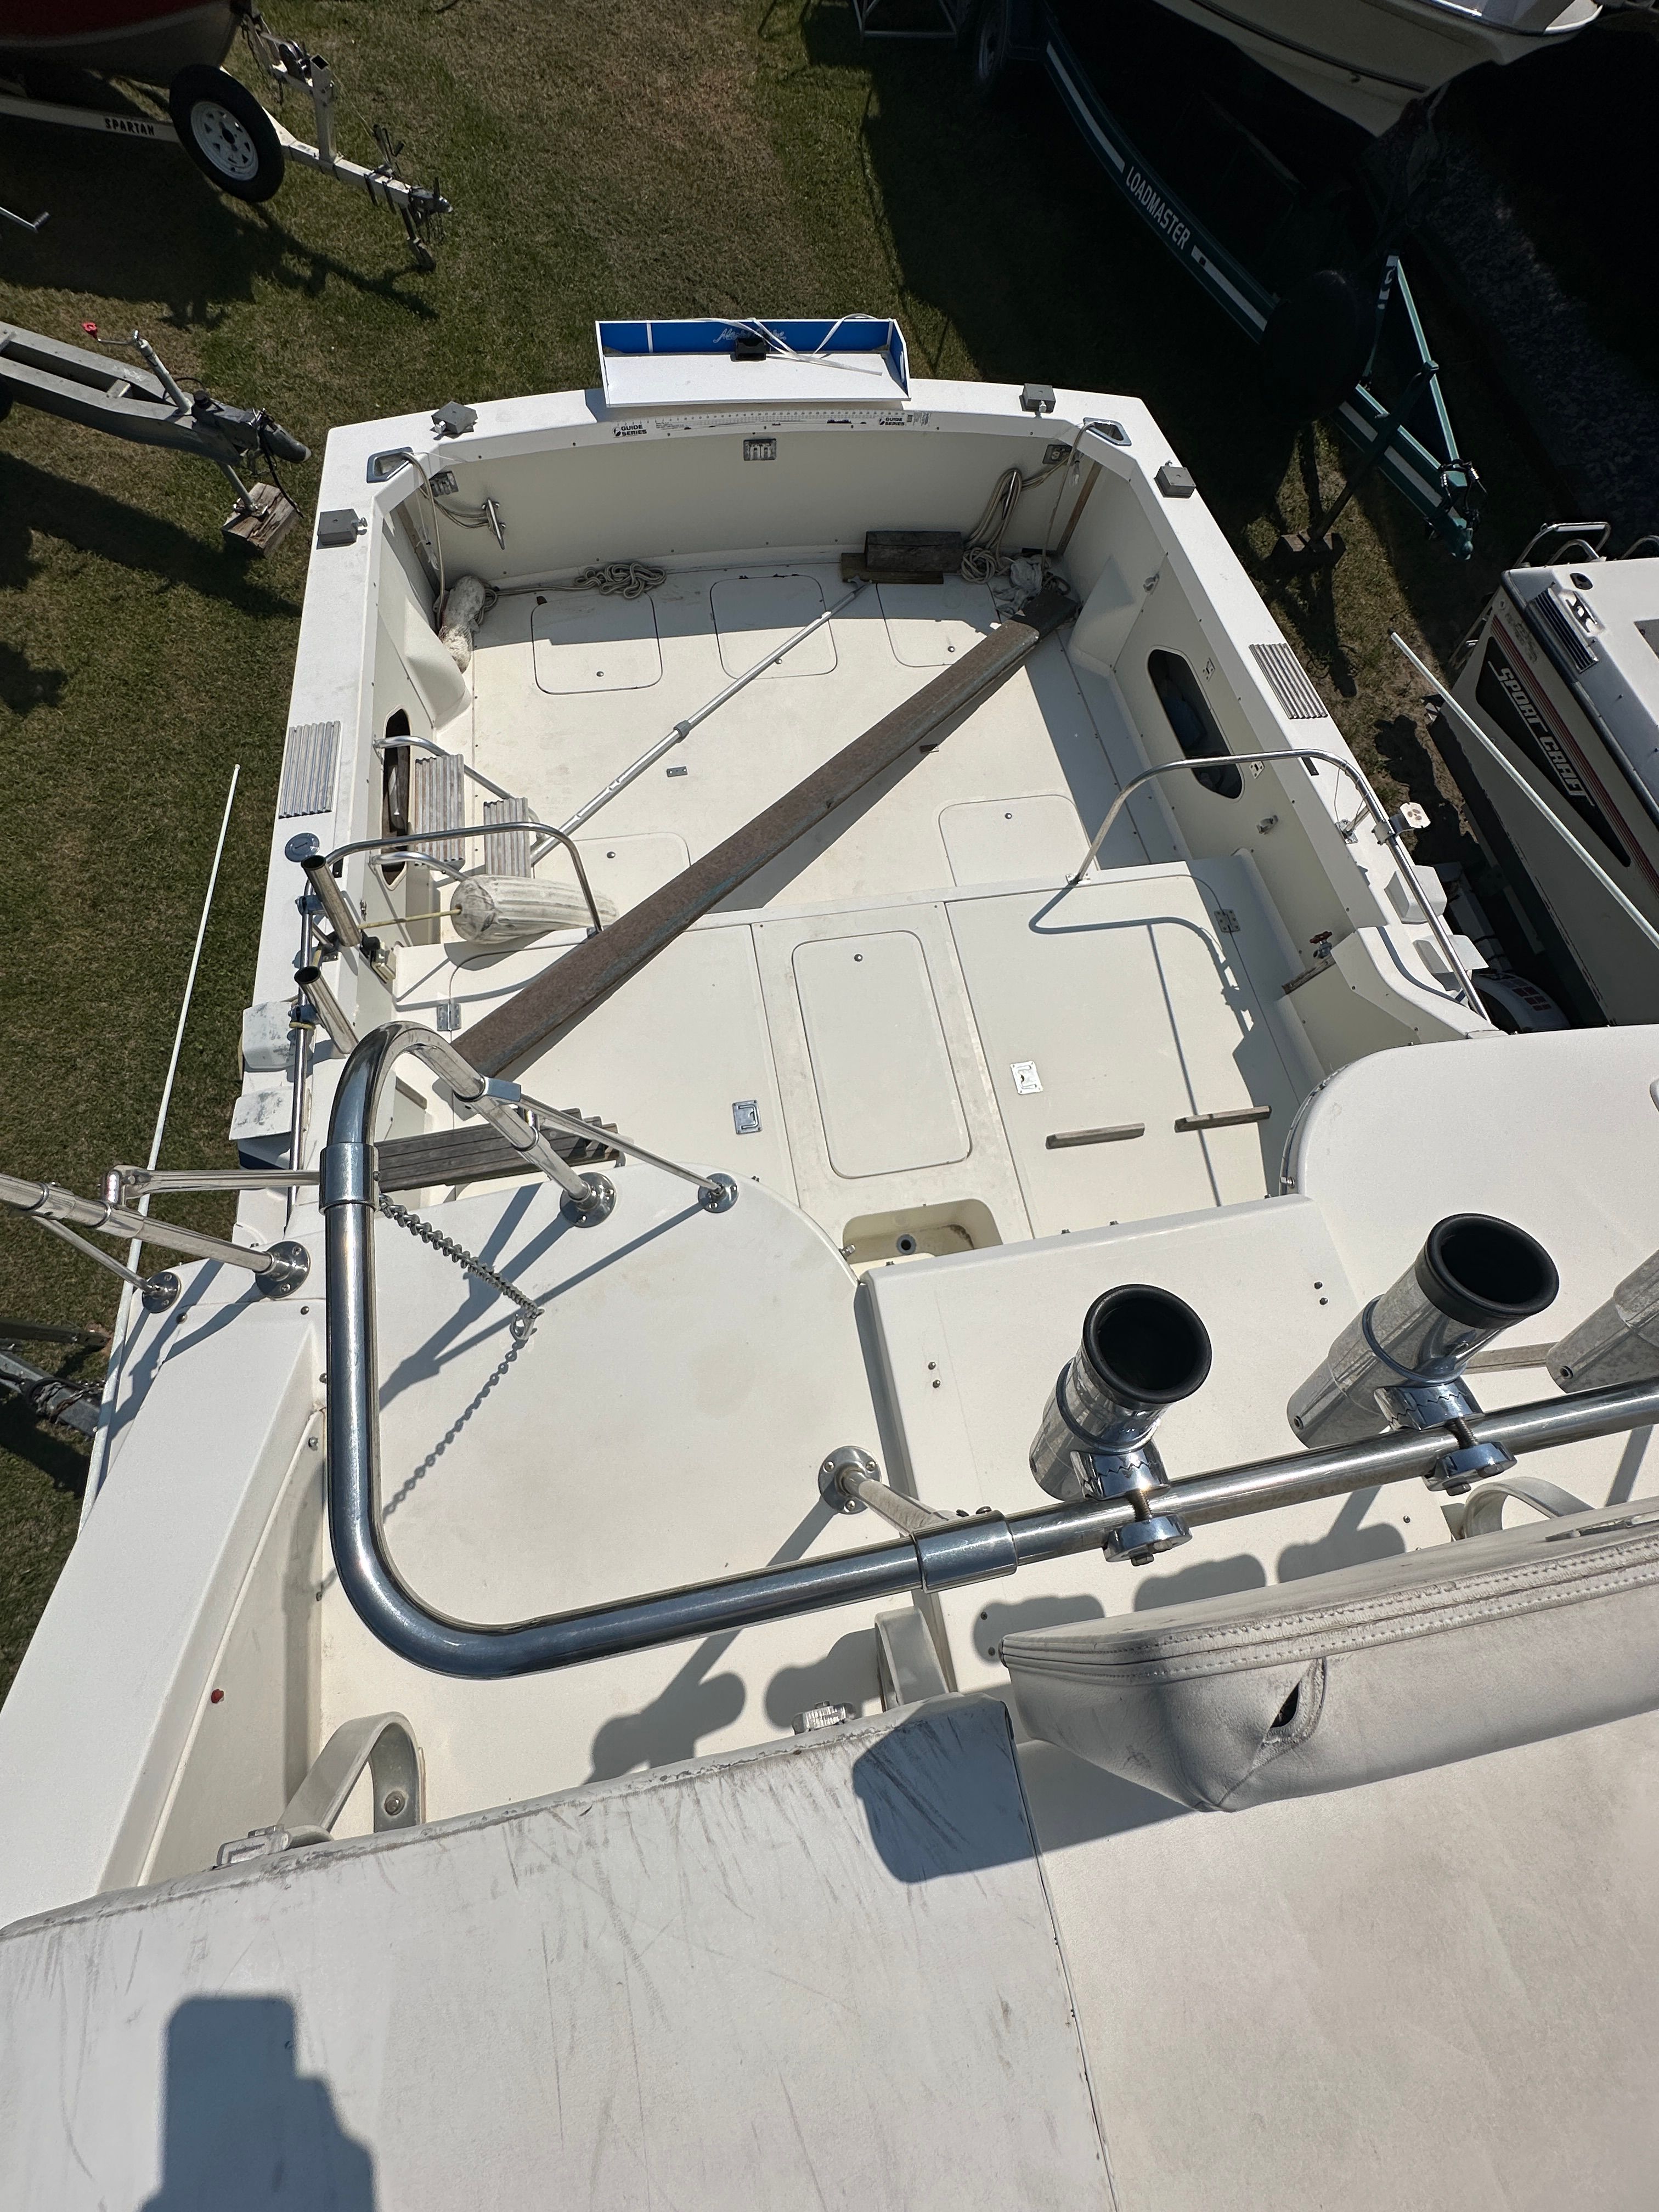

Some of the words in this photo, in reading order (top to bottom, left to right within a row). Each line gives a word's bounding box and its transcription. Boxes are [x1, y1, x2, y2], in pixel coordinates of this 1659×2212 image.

[105, 117, 155, 136] SPARTAN
[1126, 166, 1191, 250] LOADMASTER
[1487, 661, 1548, 732] SPORT
[1539, 736, 1595, 806] CRAFT
